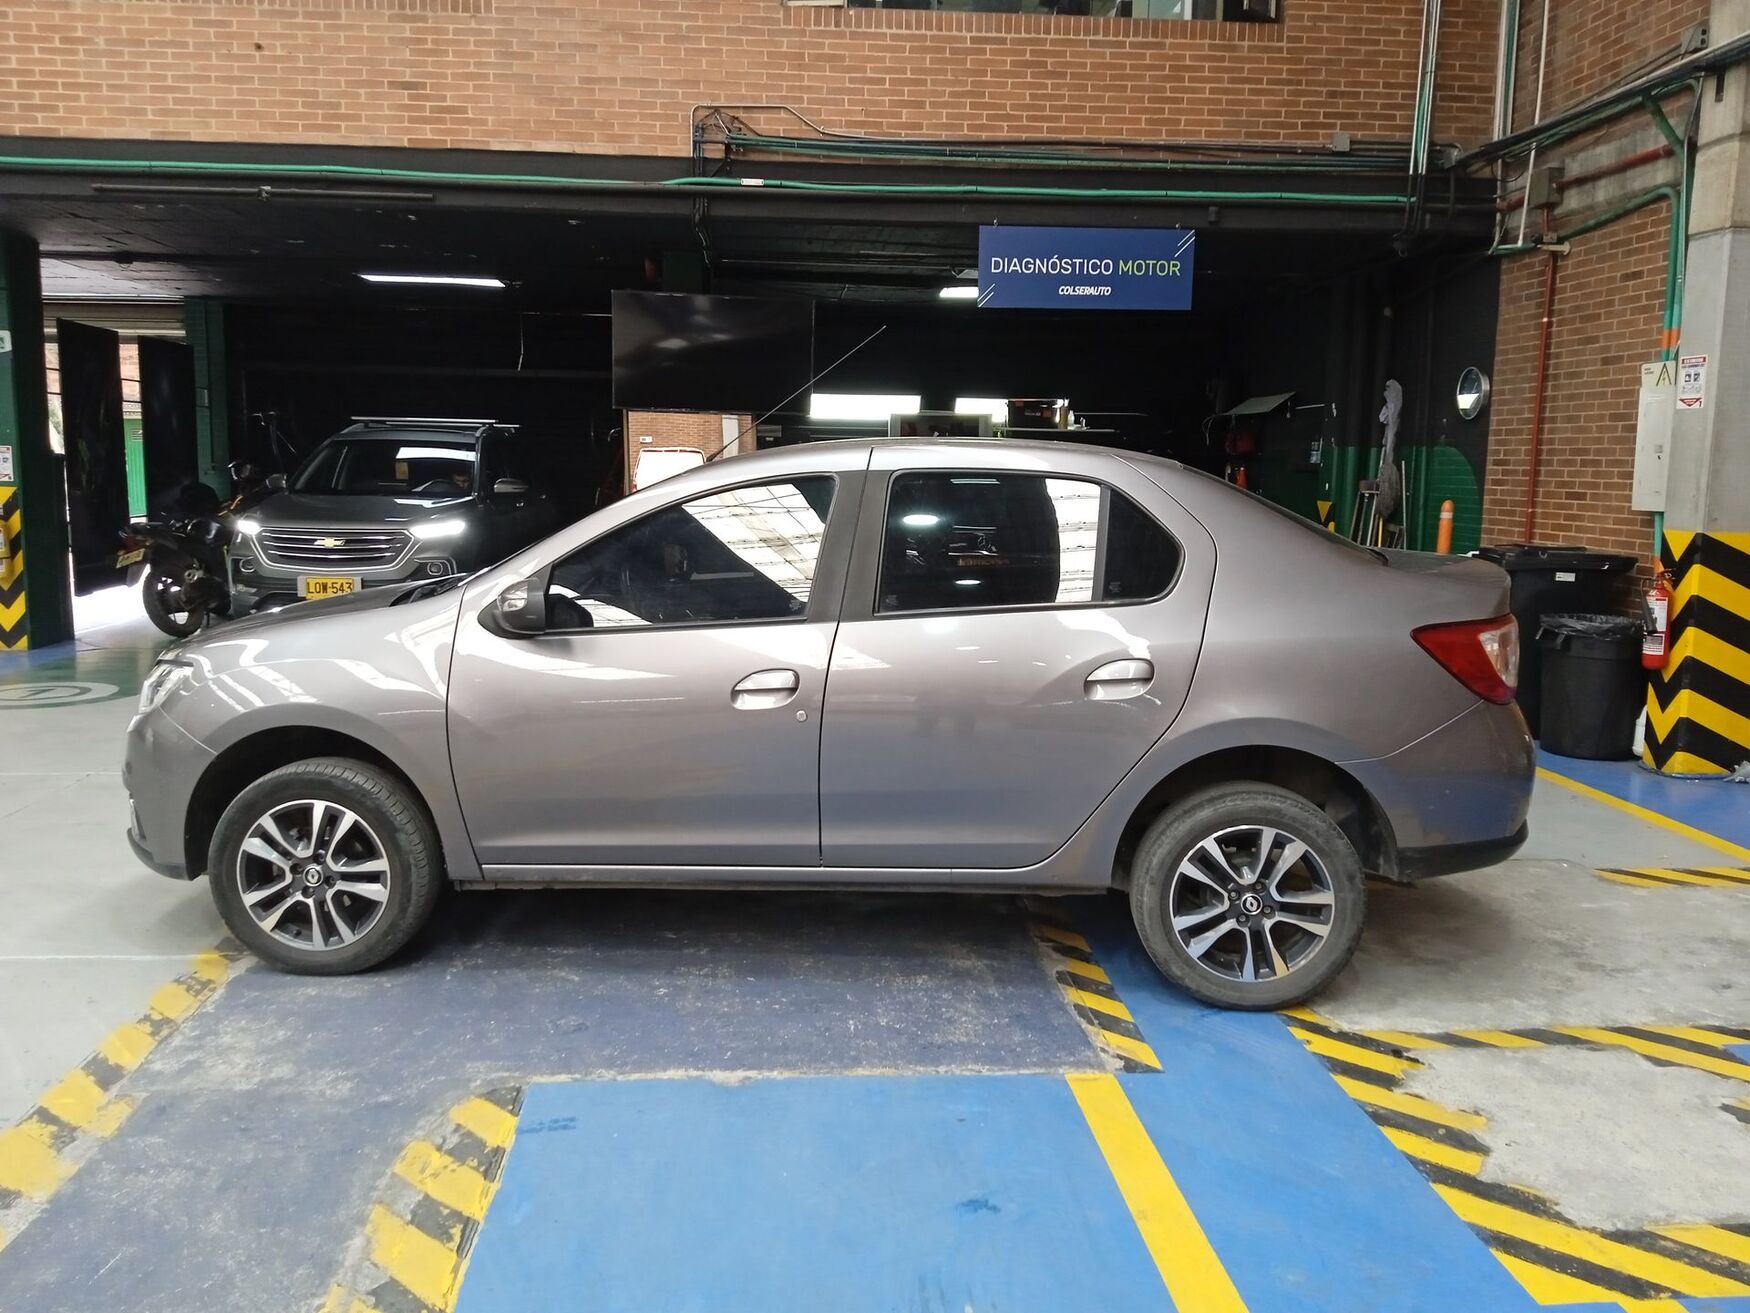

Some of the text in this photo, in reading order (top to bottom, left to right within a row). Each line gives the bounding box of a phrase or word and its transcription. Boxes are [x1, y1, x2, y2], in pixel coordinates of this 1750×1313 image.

[990, 254, 1181, 277] DIAGNÓSTICO MOTOR
[1058, 285, 1112, 296] COLSERAUTO
